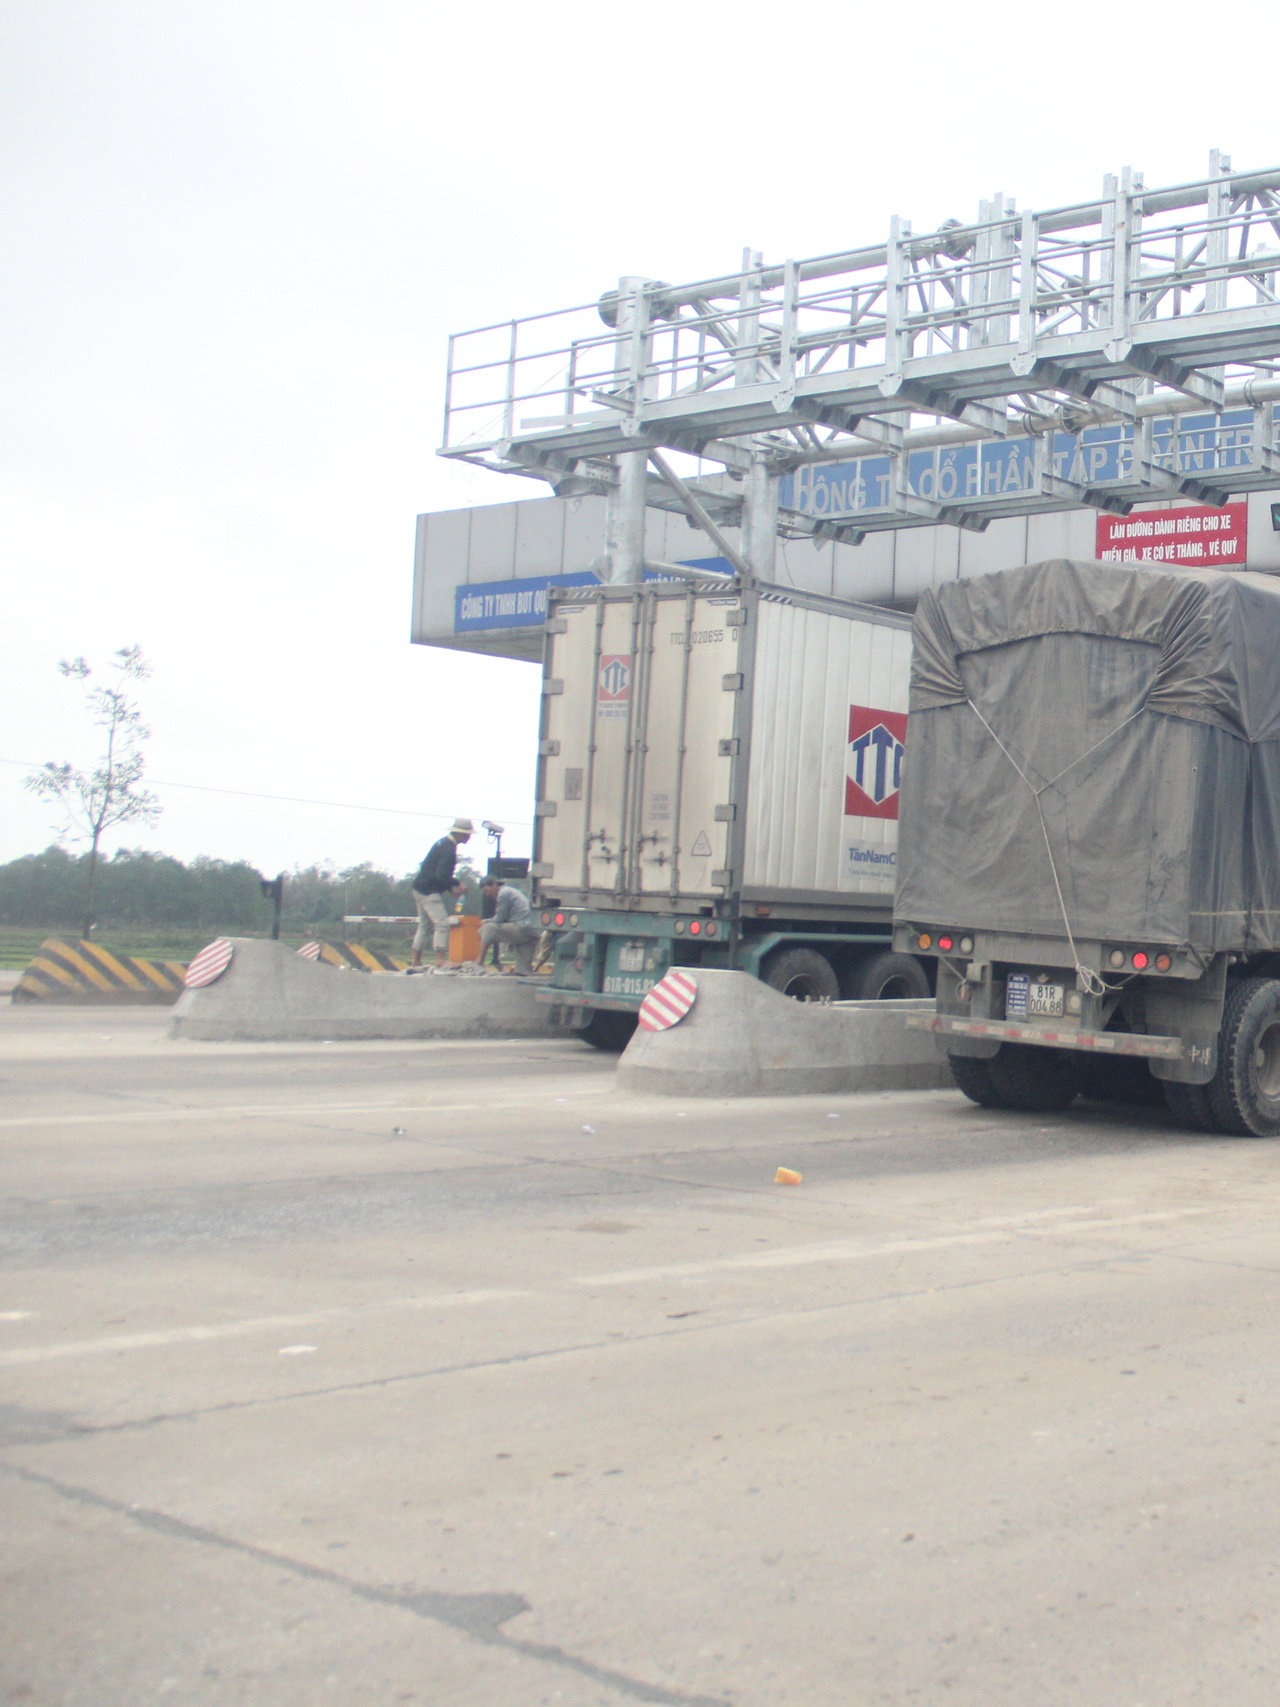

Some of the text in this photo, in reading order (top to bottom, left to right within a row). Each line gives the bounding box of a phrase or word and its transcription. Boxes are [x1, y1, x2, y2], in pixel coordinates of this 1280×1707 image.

[1110, 515, 1231, 539] LÀN ĐƯỜNG DÀNH RIÊNG CHO XE
[1142, 547, 1152, 560] XE
[1153, 542, 1164, 560] CÓ
[1165, 542, 1175, 560] VÉ
[1209, 539, 1219, 556] VÉ
[484, 594, 494, 617] TY
[1038, 986, 1055, 999] 81R
